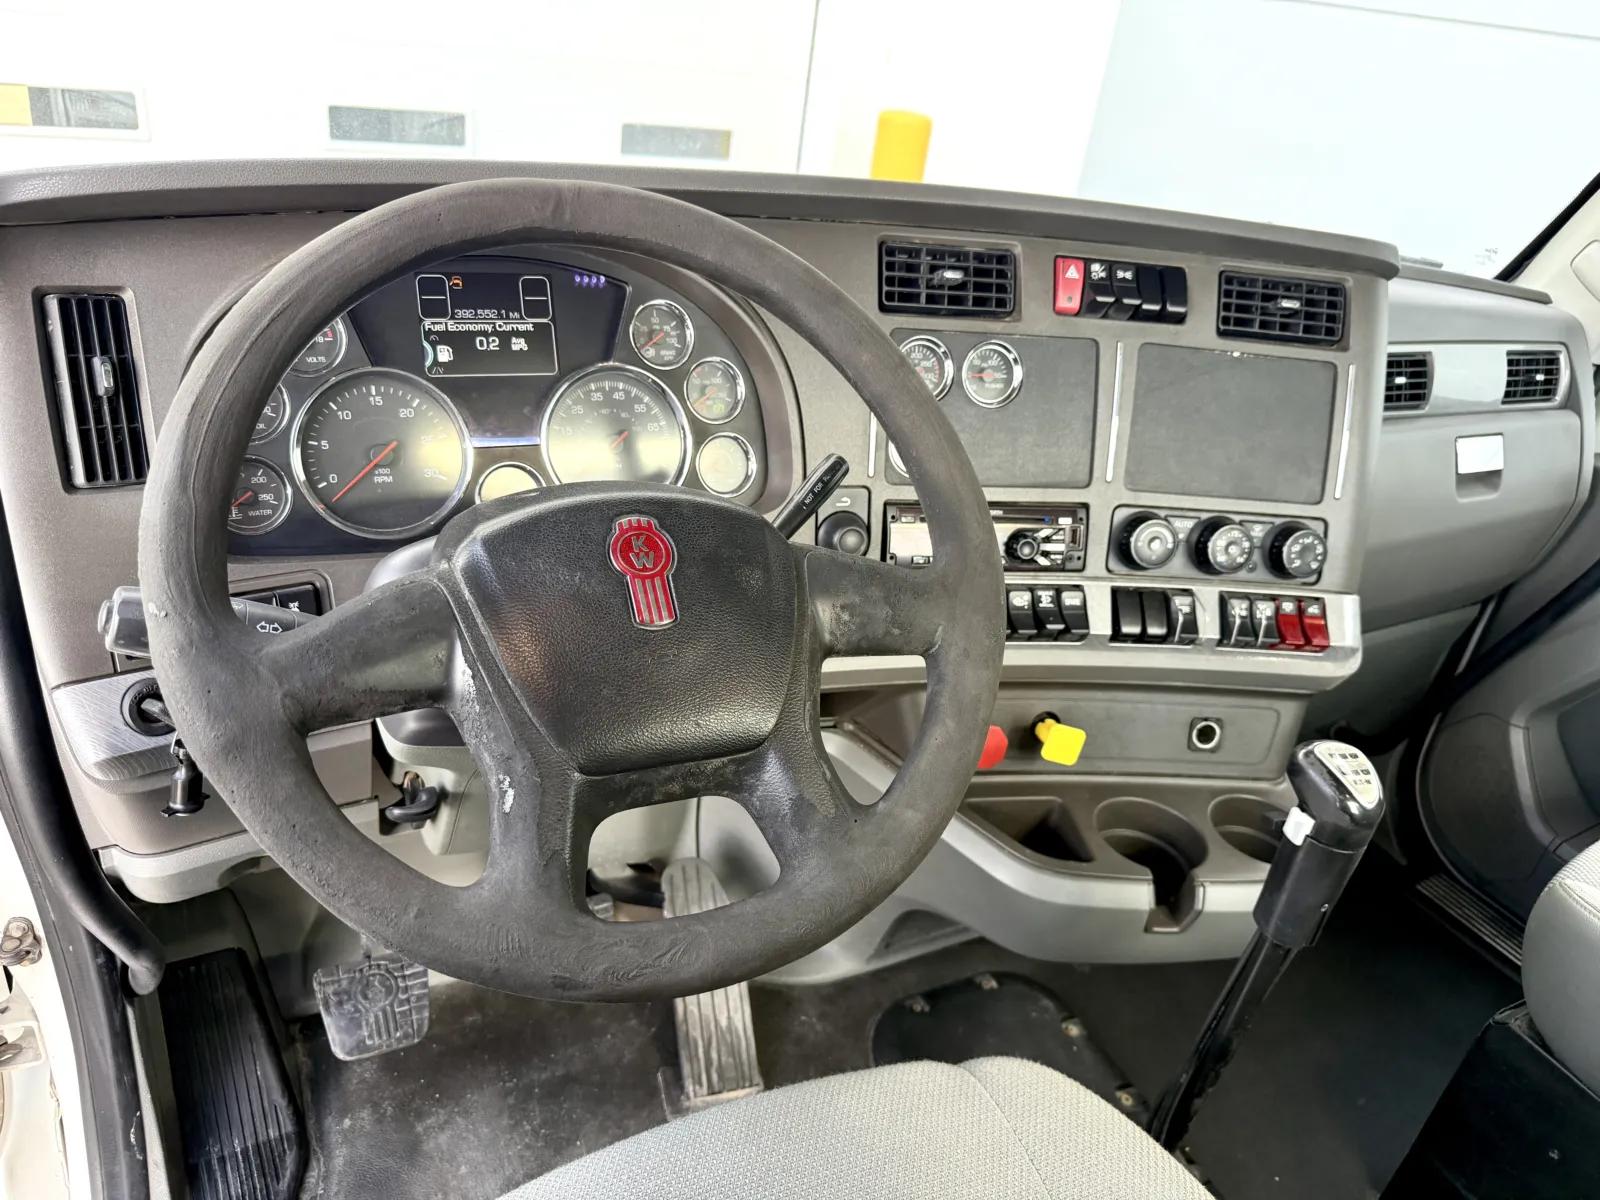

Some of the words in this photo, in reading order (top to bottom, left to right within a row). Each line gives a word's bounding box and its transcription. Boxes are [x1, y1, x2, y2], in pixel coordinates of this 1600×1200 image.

[455, 309, 506, 319] 392,552.1
[425, 322, 446, 331] Fuel
[495, 322, 534, 331] Current
[475, 337, 500, 351] 0.2
[591, 392, 604, 401] 35
[612, 391, 625, 400] 45
[369, 396, 383, 406] 15
[398, 408, 415, 418] 20
[571, 405, 584, 415] 25
[634, 404, 647, 413] 55
[337, 410, 352, 420] 10
[647, 422, 660, 432] 65
[321, 440, 330, 450] 5
[251, 476, 267, 484] 200
[329, 474, 338, 484] 0
[374, 475, 393, 484] RPM
[258, 493, 274, 501] 250
[804, 492, 815, 505] NOT
[813, 481, 824, 493] FOR
[1173, 520, 1193, 529] AUTO
